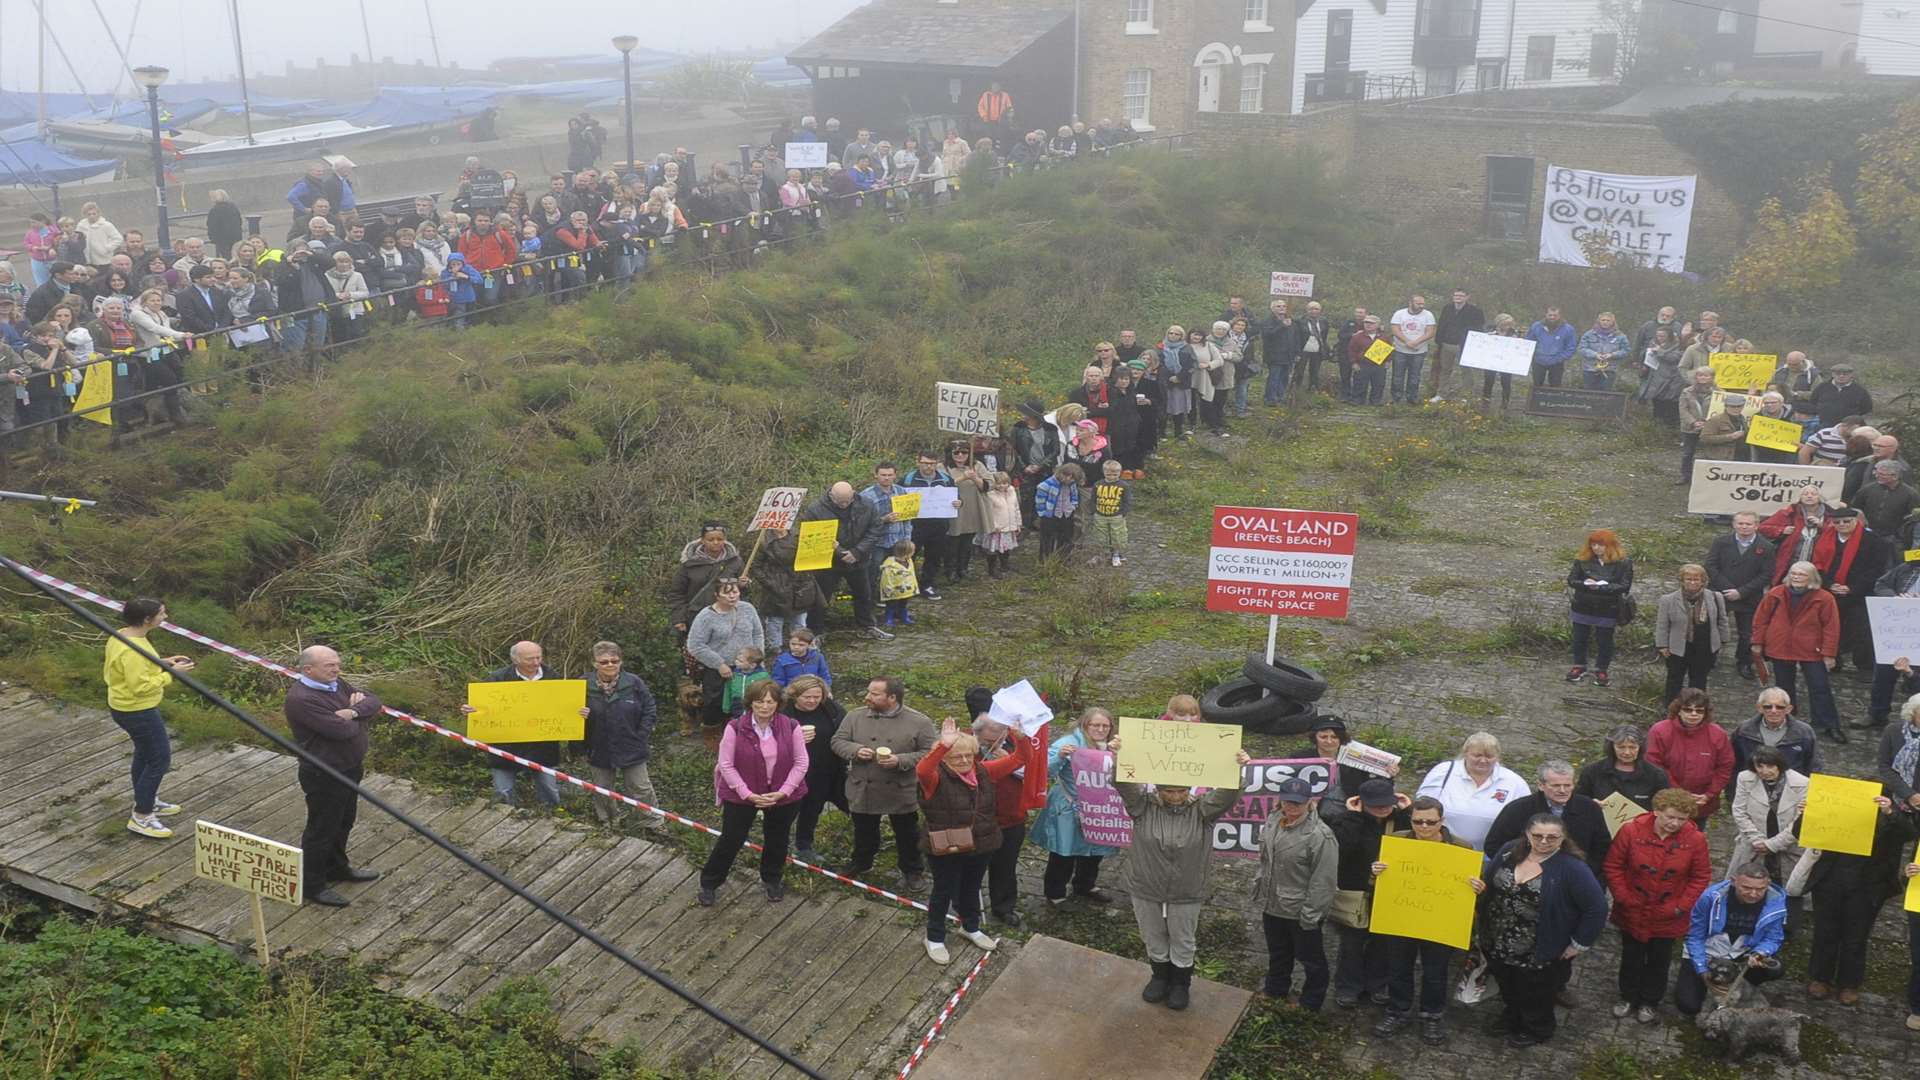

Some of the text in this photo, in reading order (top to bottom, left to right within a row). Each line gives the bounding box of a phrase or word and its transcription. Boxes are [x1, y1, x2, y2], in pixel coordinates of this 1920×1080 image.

[1551, 168, 1640, 205] follow
[941, 388, 998, 411] RETURN
[957, 406, 979, 420] TO
[937, 415, 997, 436] TENDER
[1220, 515, 1280, 533] OVAL
[1234, 532, 1332, 548] (REEVES BEACH)
[1215, 554, 1240, 563] CCC
[1243, 555, 1290, 567] SELLING
[1216, 565, 1260, 575] WORTH
[1263, 568, 1277, 576] £1
[1216, 585, 1340, 601] FIGHT IT FOR MORE
[1238, 597, 1316, 610] OPEN SPACE
[487, 690, 529, 704] SAVE
[473, 719, 520, 728] PUBLIC
[1141, 721, 1200, 745] Right
[1164, 743, 1196, 753] this
[1145, 751, 1206, 777] Wrong
[1241, 764, 1329, 793] USC
[1081, 800, 1120, 815] Trade
[197, 823, 292, 858] WE THE PEOPLE OF
[198, 838, 298, 877] WHITSTABLE
[201, 862, 241, 883] LEFT
[208, 855, 288, 886] HAVE BEEN
